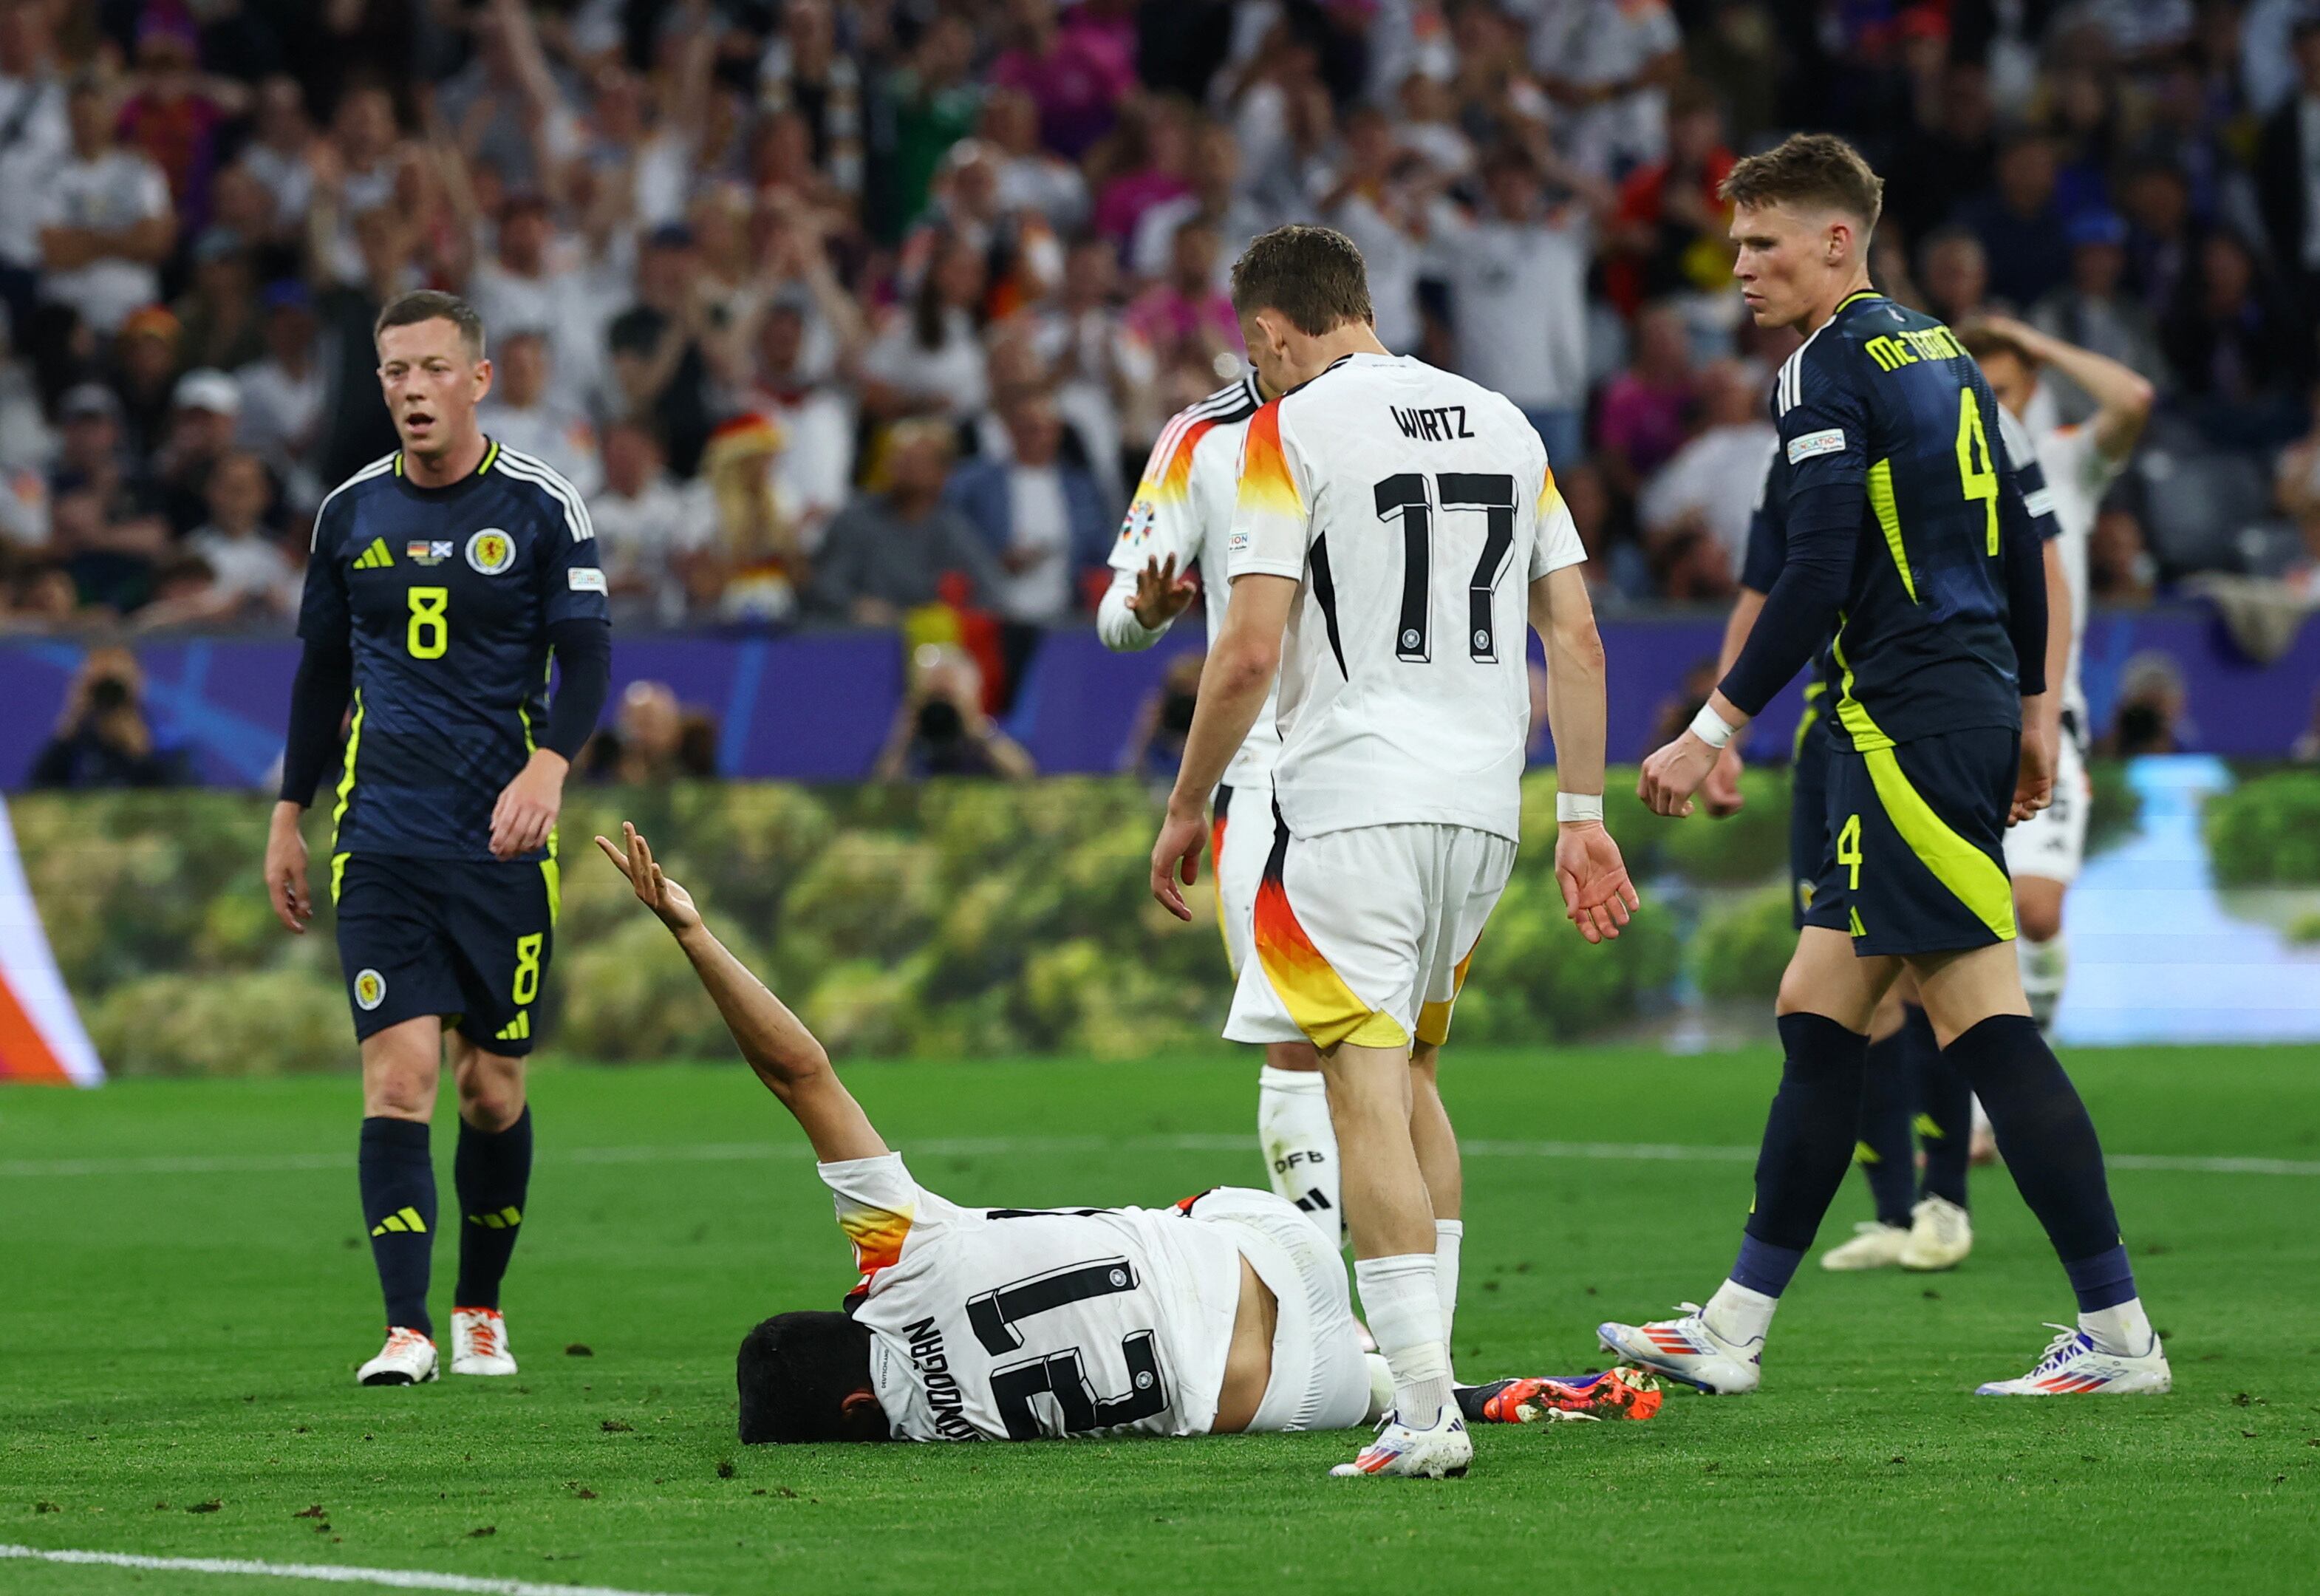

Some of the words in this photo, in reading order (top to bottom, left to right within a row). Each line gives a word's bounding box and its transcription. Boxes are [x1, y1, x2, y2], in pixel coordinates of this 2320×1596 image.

[1390, 405, 1475, 442] WIRTZ
[1956, 386, 1999, 556] 4
[1374, 472, 1519, 664] 17
[407, 586, 448, 660] 8
[1838, 814, 1863, 890] 4
[512, 932, 543, 1006] 8
[1275, 1150, 1325, 1174] DFB
[881, 1348, 890, 1389] DEUTSCHLAND
[965, 1255, 1170, 1440] 21
